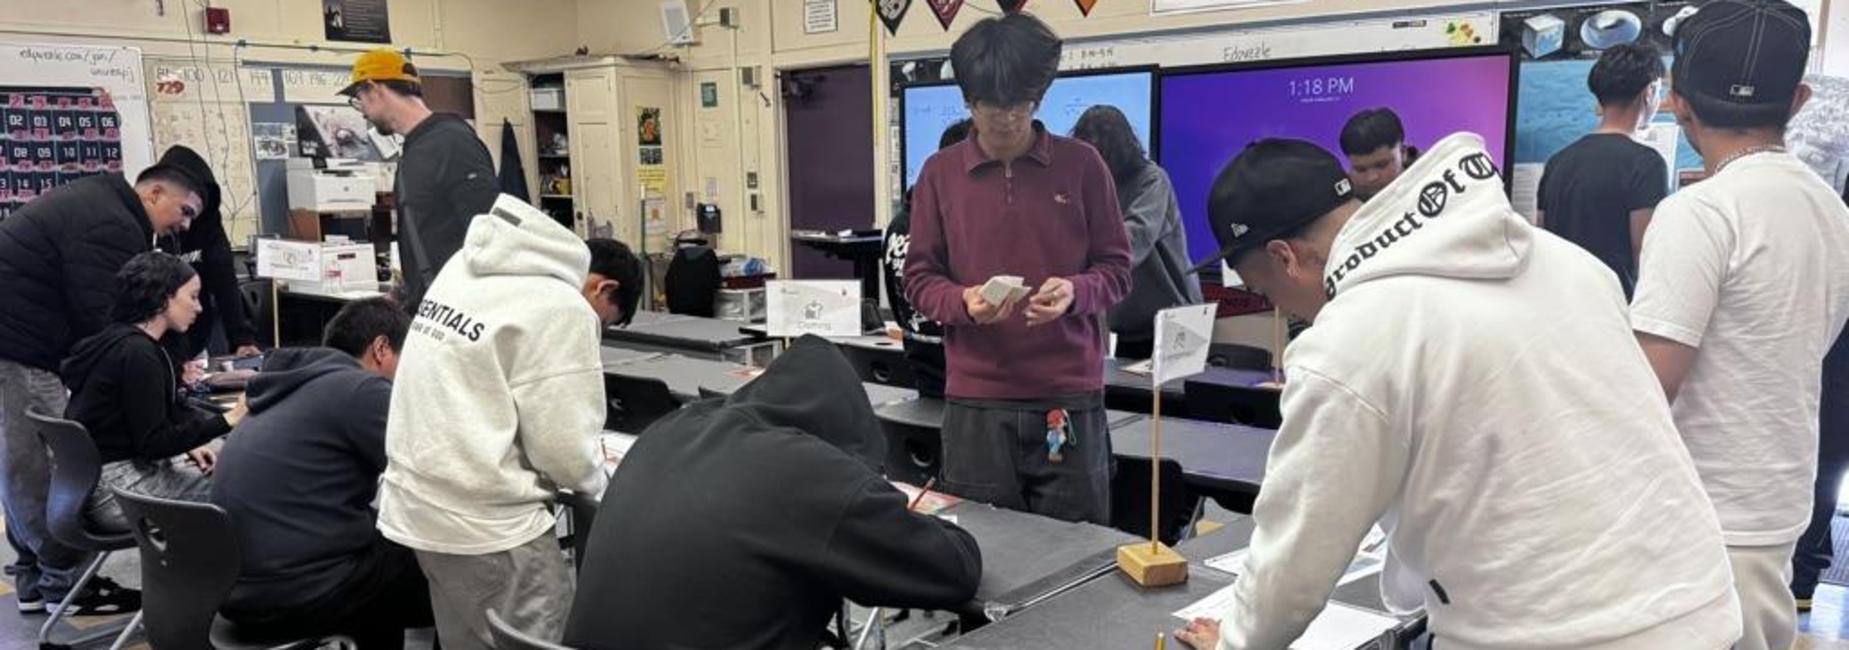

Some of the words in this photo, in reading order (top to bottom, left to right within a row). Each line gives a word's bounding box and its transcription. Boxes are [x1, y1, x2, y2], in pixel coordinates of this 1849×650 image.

[1289, 78, 1323, 96] 1:18
[1327, 77, 1354, 94] PM
[9, 115, 23, 126] 02
[58, 116, 72, 128] 04
[79, 116, 91, 128] 05
[101, 116, 114, 128] 06
[14, 147, 28, 158] 08
[63, 147, 75, 158] 10
[85, 147, 97, 158] 11
[105, 147, 118, 158] 12
